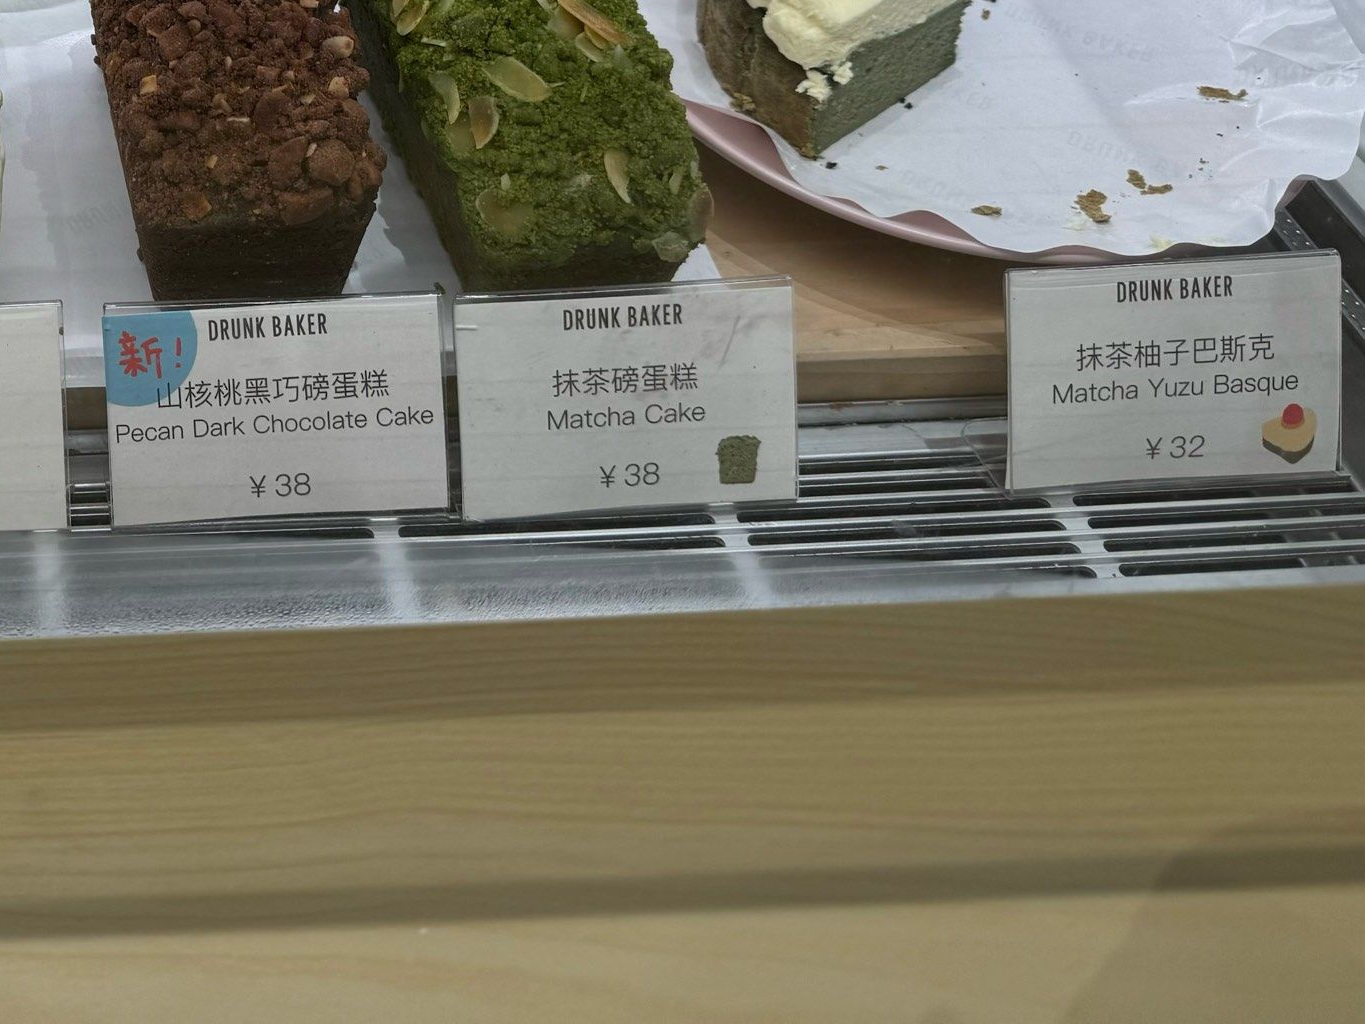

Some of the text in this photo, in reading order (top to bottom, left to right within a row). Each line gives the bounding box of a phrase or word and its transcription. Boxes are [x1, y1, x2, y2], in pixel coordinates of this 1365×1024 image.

[1117, 275, 1233, 303] DRUNK BAKER
[208, 313, 328, 341] DRUNK BAKER
[563, 303, 682, 331] DRUNK BAKER
[1076, 332, 1275, 372] 抹茶柚子巴斯克
[157, 369, 389, 409] 山核桃黑巧磅蛋糕
[552, 362, 699, 398] 抹茶磅蛋糕
[1052, 373, 1299, 404] Matcha Yuzu Basque
[116, 406, 434, 443] Pecan Dark Chocolate Cake
[547, 401, 706, 430] Matcha Cake
